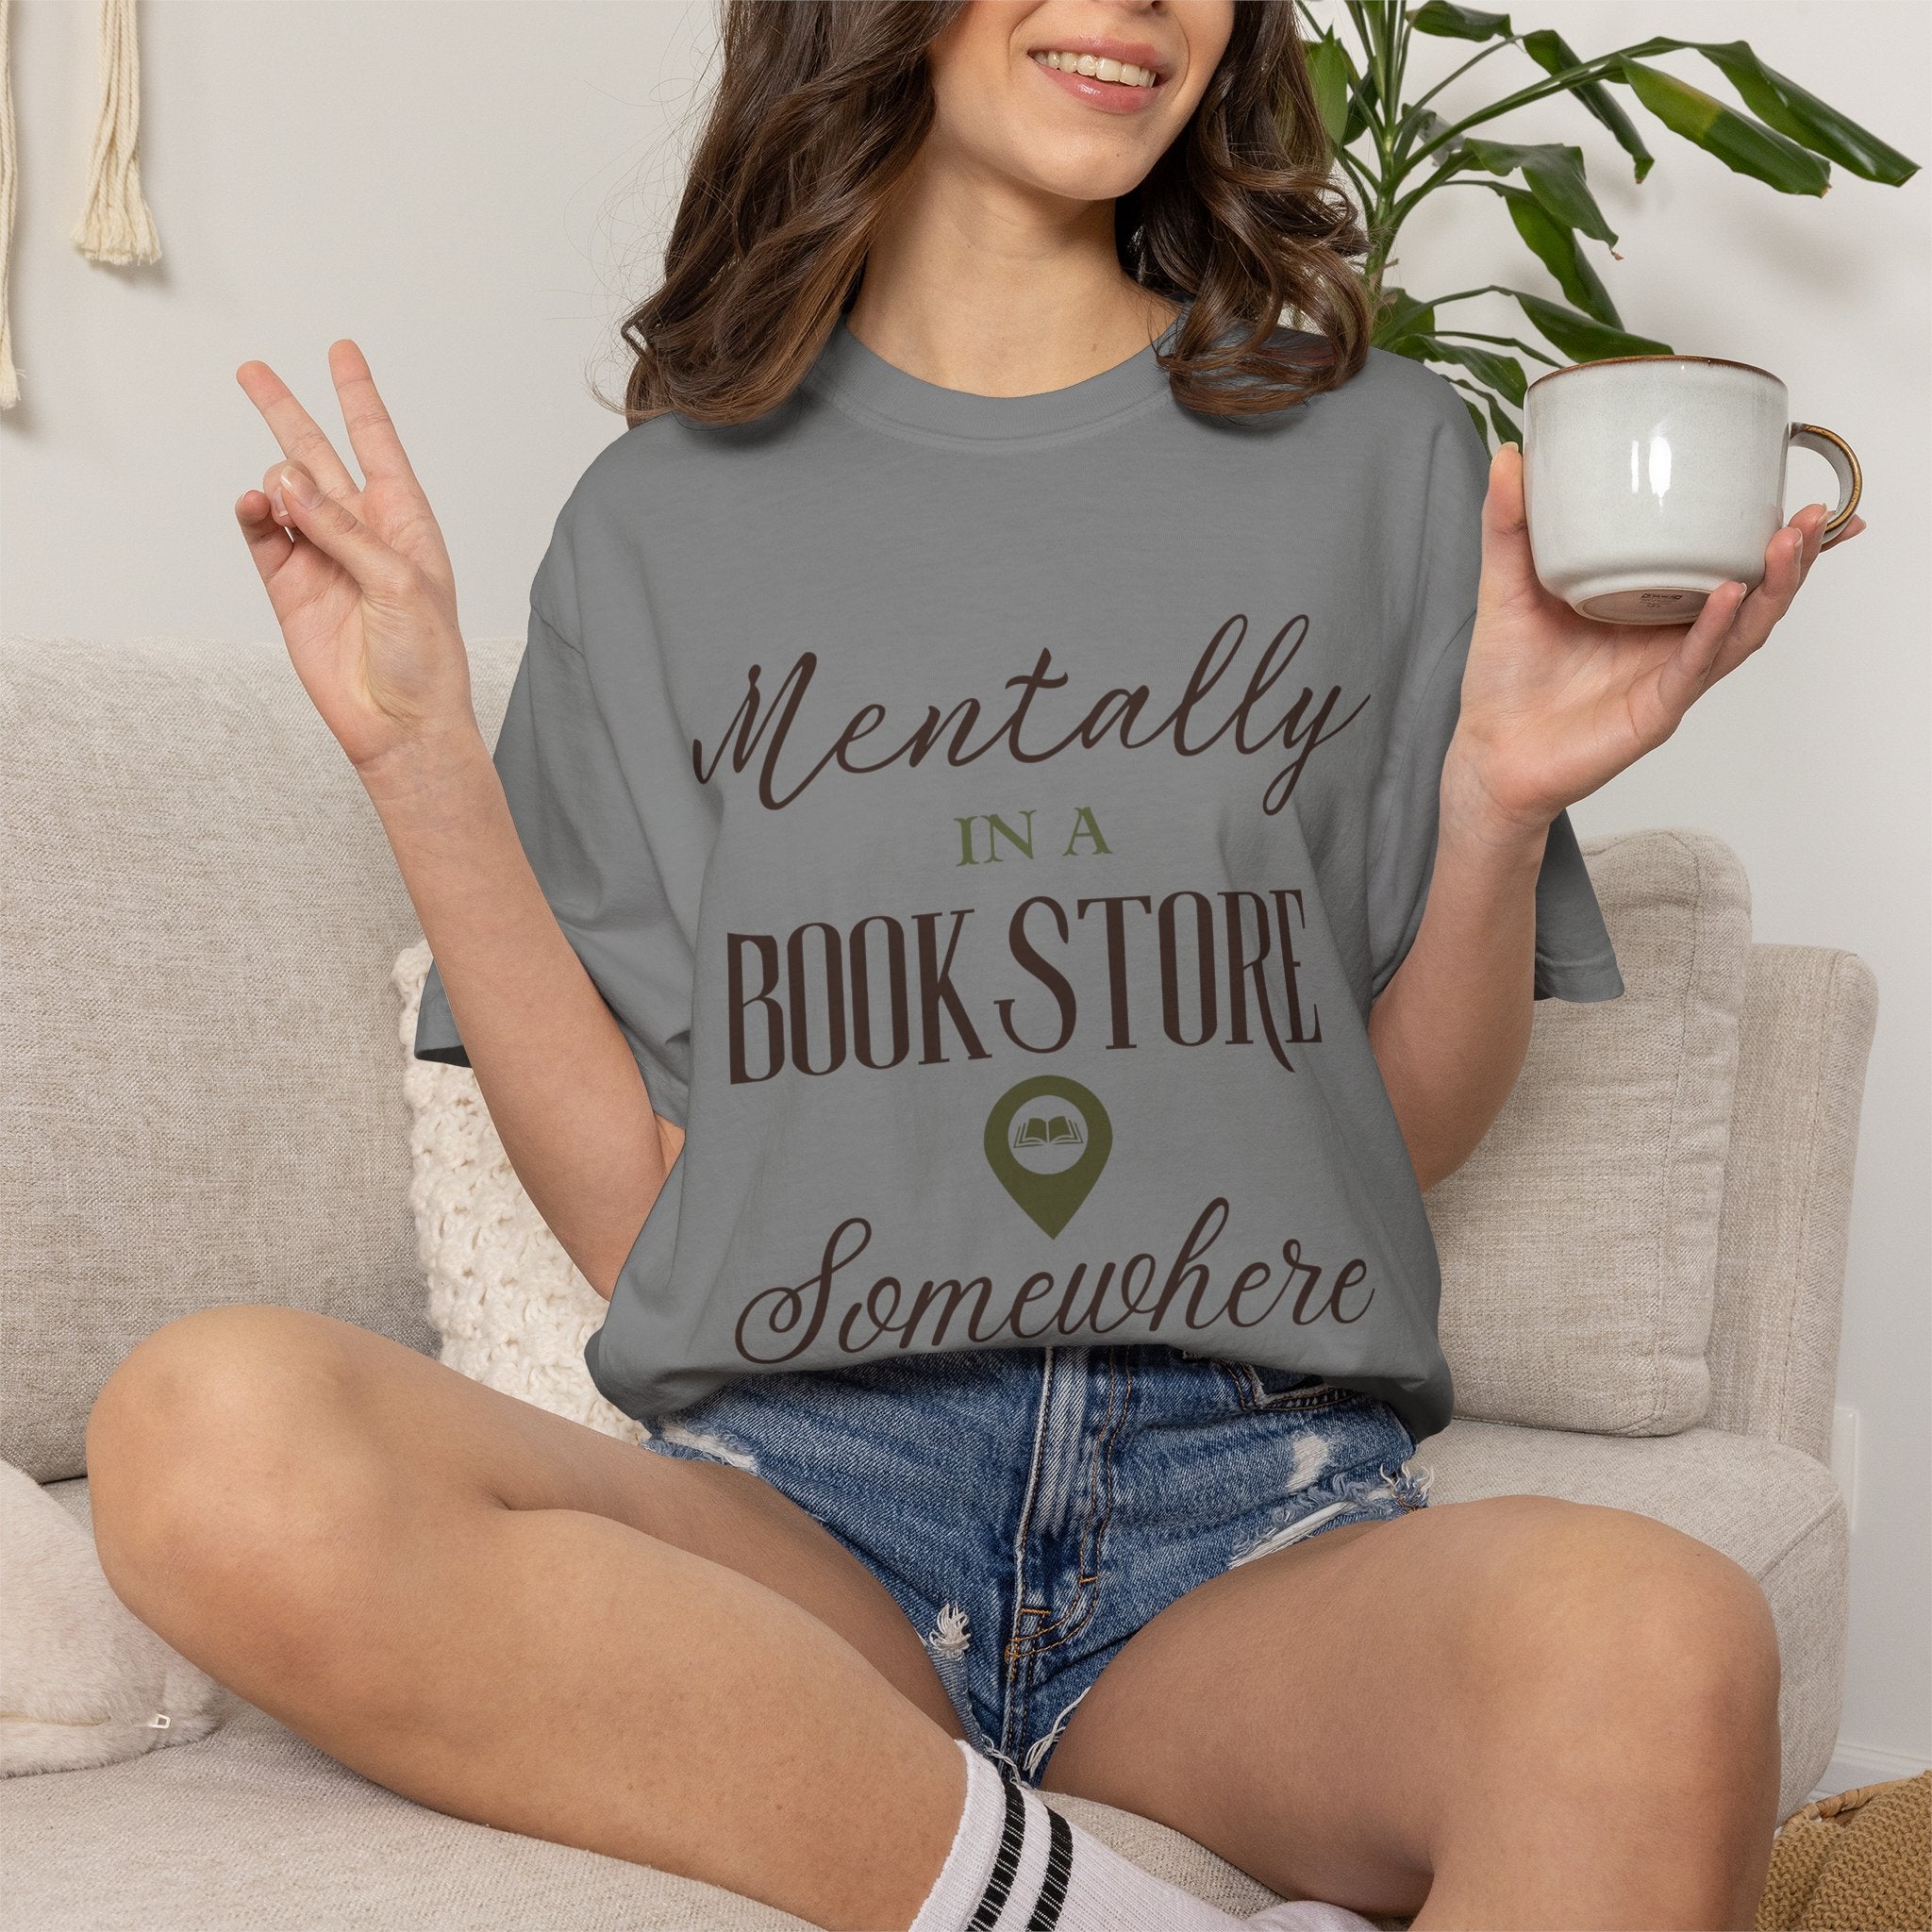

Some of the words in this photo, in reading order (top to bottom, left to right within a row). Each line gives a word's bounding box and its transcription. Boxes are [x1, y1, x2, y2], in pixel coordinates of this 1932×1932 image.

[692, 613, 1371, 815] Mentally
[954, 808, 1038, 867] IN
[1062, 806, 1113, 857] A
[735, 1197, 1375, 1365] Somewhere
